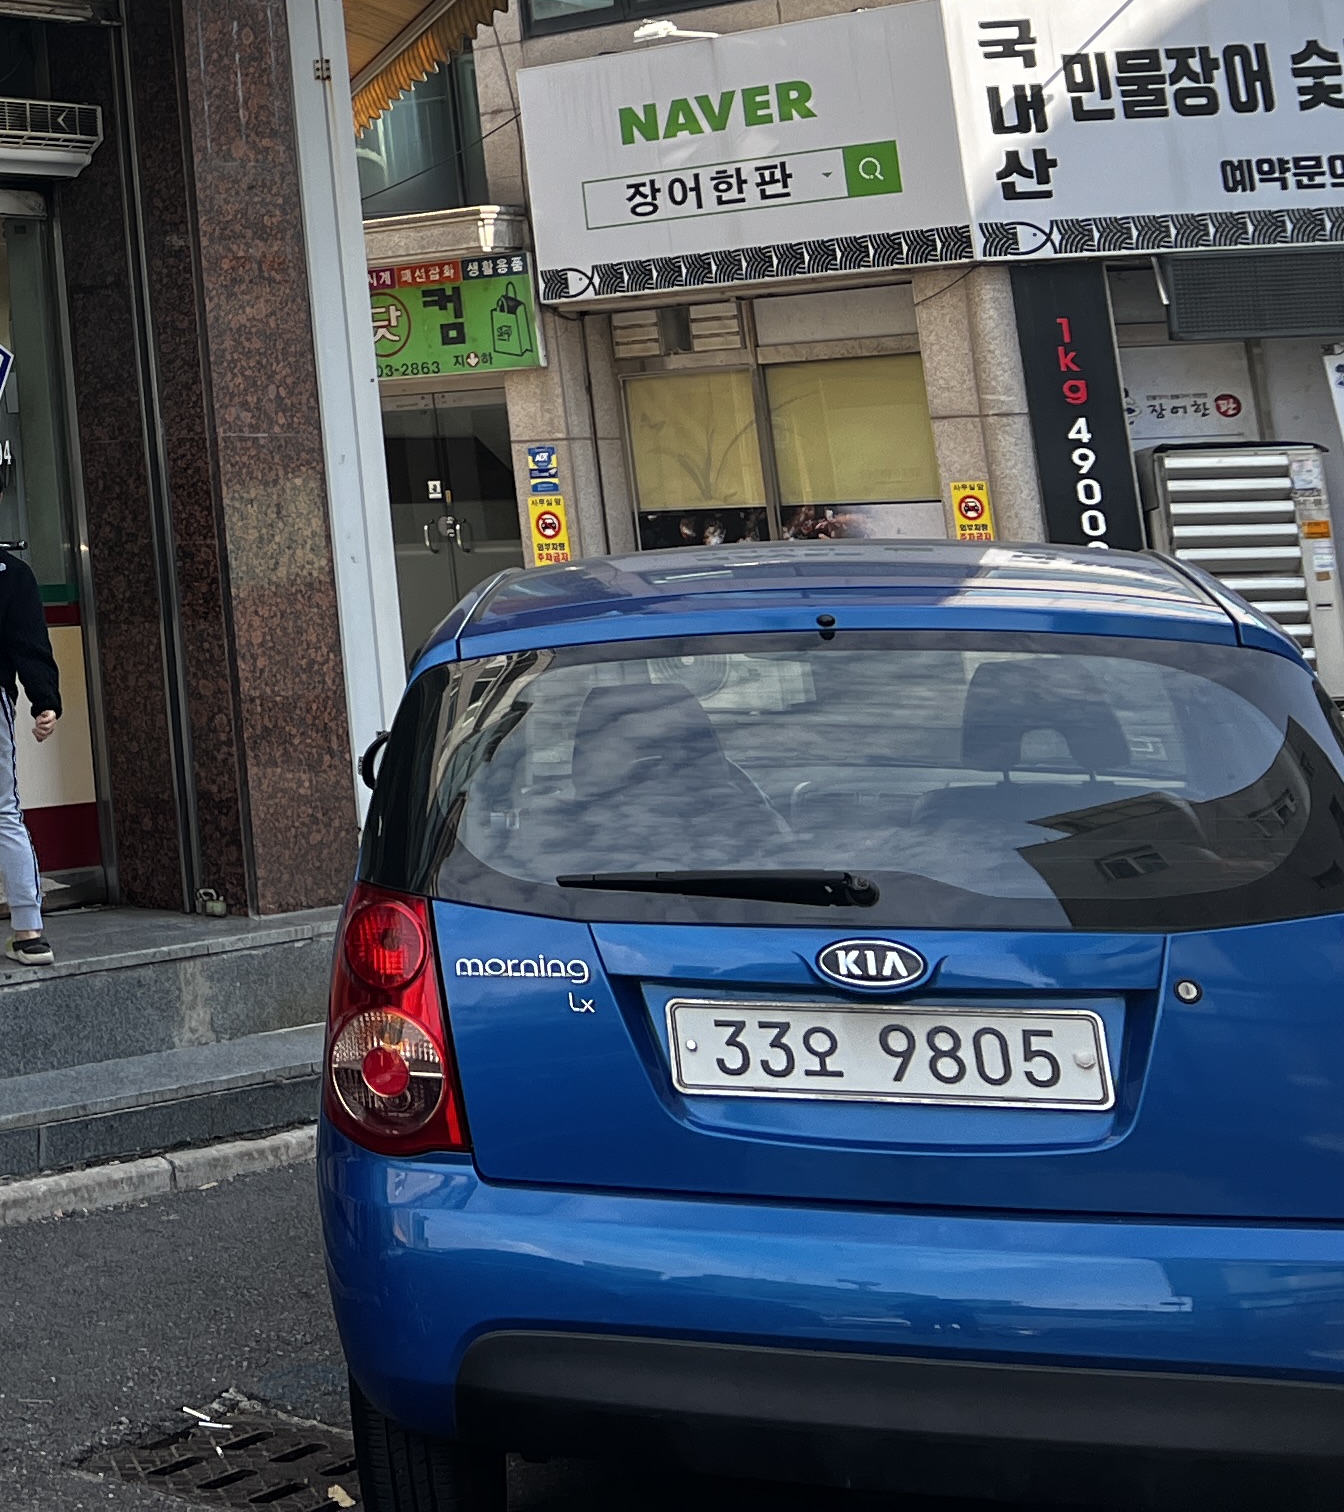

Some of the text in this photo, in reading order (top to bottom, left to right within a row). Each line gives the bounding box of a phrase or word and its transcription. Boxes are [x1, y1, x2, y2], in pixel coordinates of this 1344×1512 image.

[618, 79, 817, 145] NAVER
[978, 18, 1058, 202] 국내산
[1061, 42, 1277, 122] 민물장어
[625, 161, 793, 217] 장어한판
[400, 265, 455, 283] 패션잡화
[466, 256, 524, 277] 생활용품
[1056, 317, 1088, 405] 1kg
[456, 954, 589, 984] morning
[835, 950, 918, 980] KIA
[713, 1019, 1063, 1089] 33오 9805
